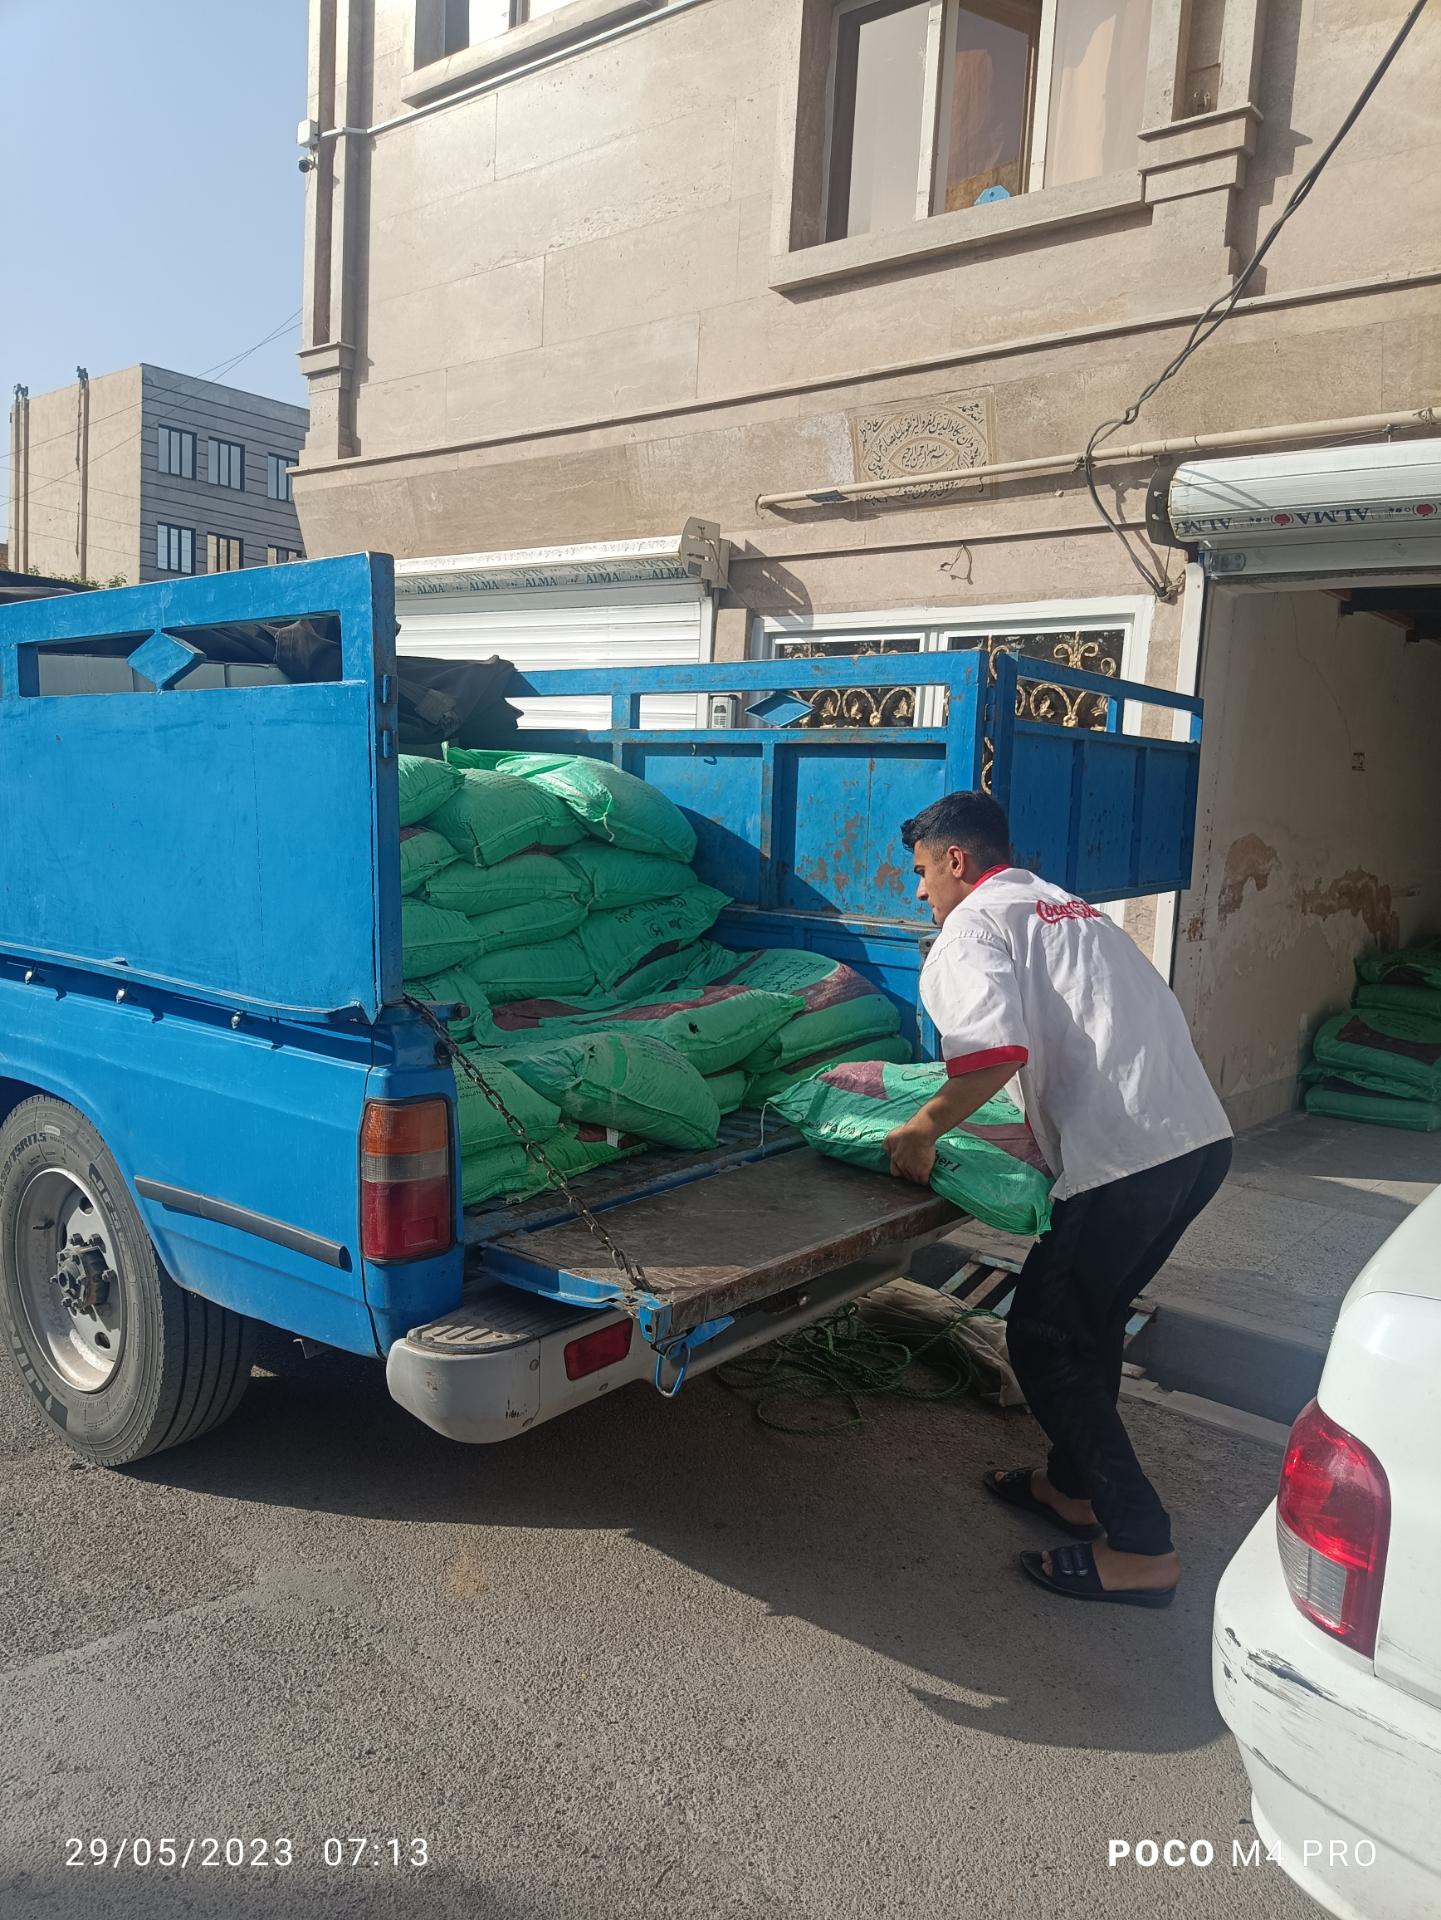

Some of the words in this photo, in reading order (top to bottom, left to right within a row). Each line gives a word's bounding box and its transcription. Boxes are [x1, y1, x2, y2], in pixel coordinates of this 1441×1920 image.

[1296, 508, 1369, 525] ALMA
[417, 583, 445, 595] ALMA
[469, 580, 499, 591] ALMA
[525, 576, 558, 588] ALMA
[586, 572, 620, 584] ALMA
[651, 567, 688, 579] ALMA
